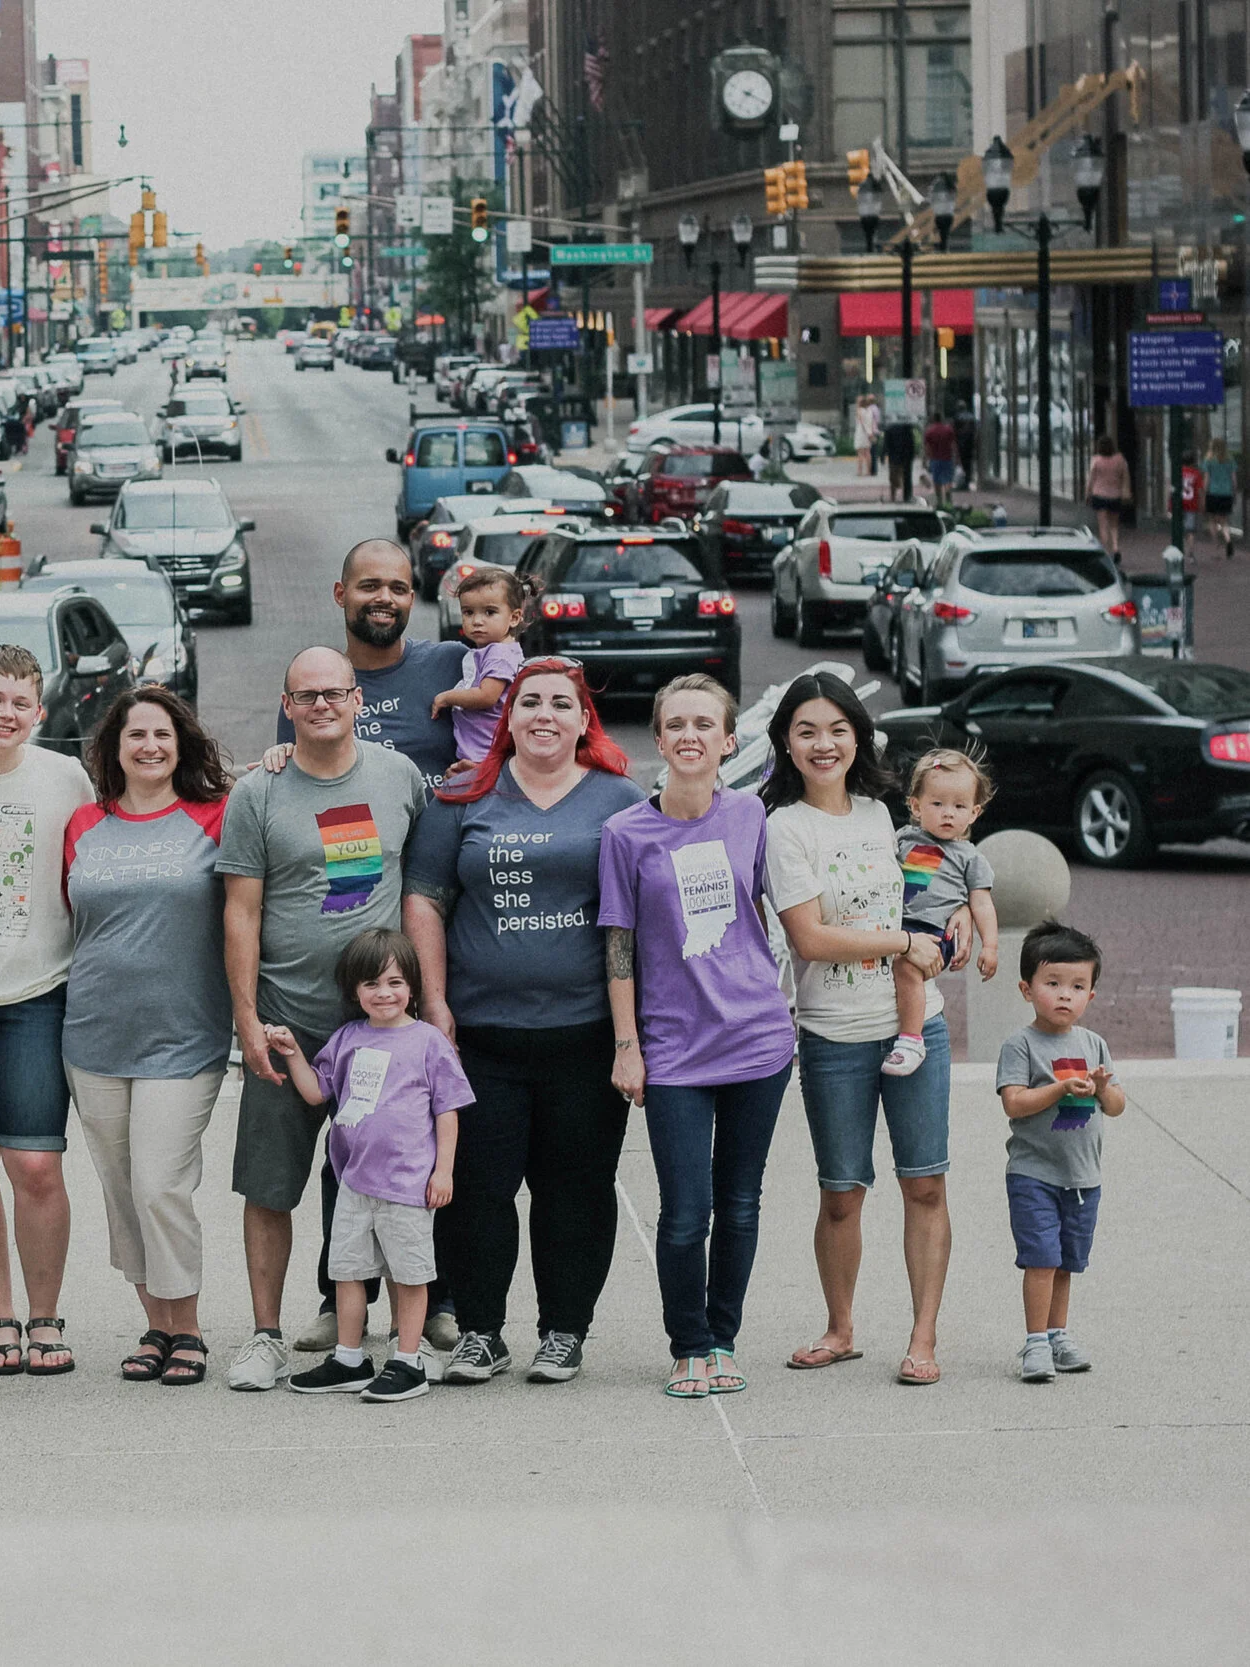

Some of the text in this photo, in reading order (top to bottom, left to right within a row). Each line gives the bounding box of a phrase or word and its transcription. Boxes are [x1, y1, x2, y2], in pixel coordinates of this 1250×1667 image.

[492, 832, 554, 844] never
[86, 840, 187, 862] KINDNESS
[334, 840, 369, 856] YOU
[488, 845, 524, 863] the
[80, 860, 184, 885] MATTERS
[489, 868, 534, 885] less
[681, 869, 728, 886] HOOSIER
[683, 880, 729, 897] FEMINIST
[493, 890, 531, 908] she
[497, 907, 590, 935] persisted.
